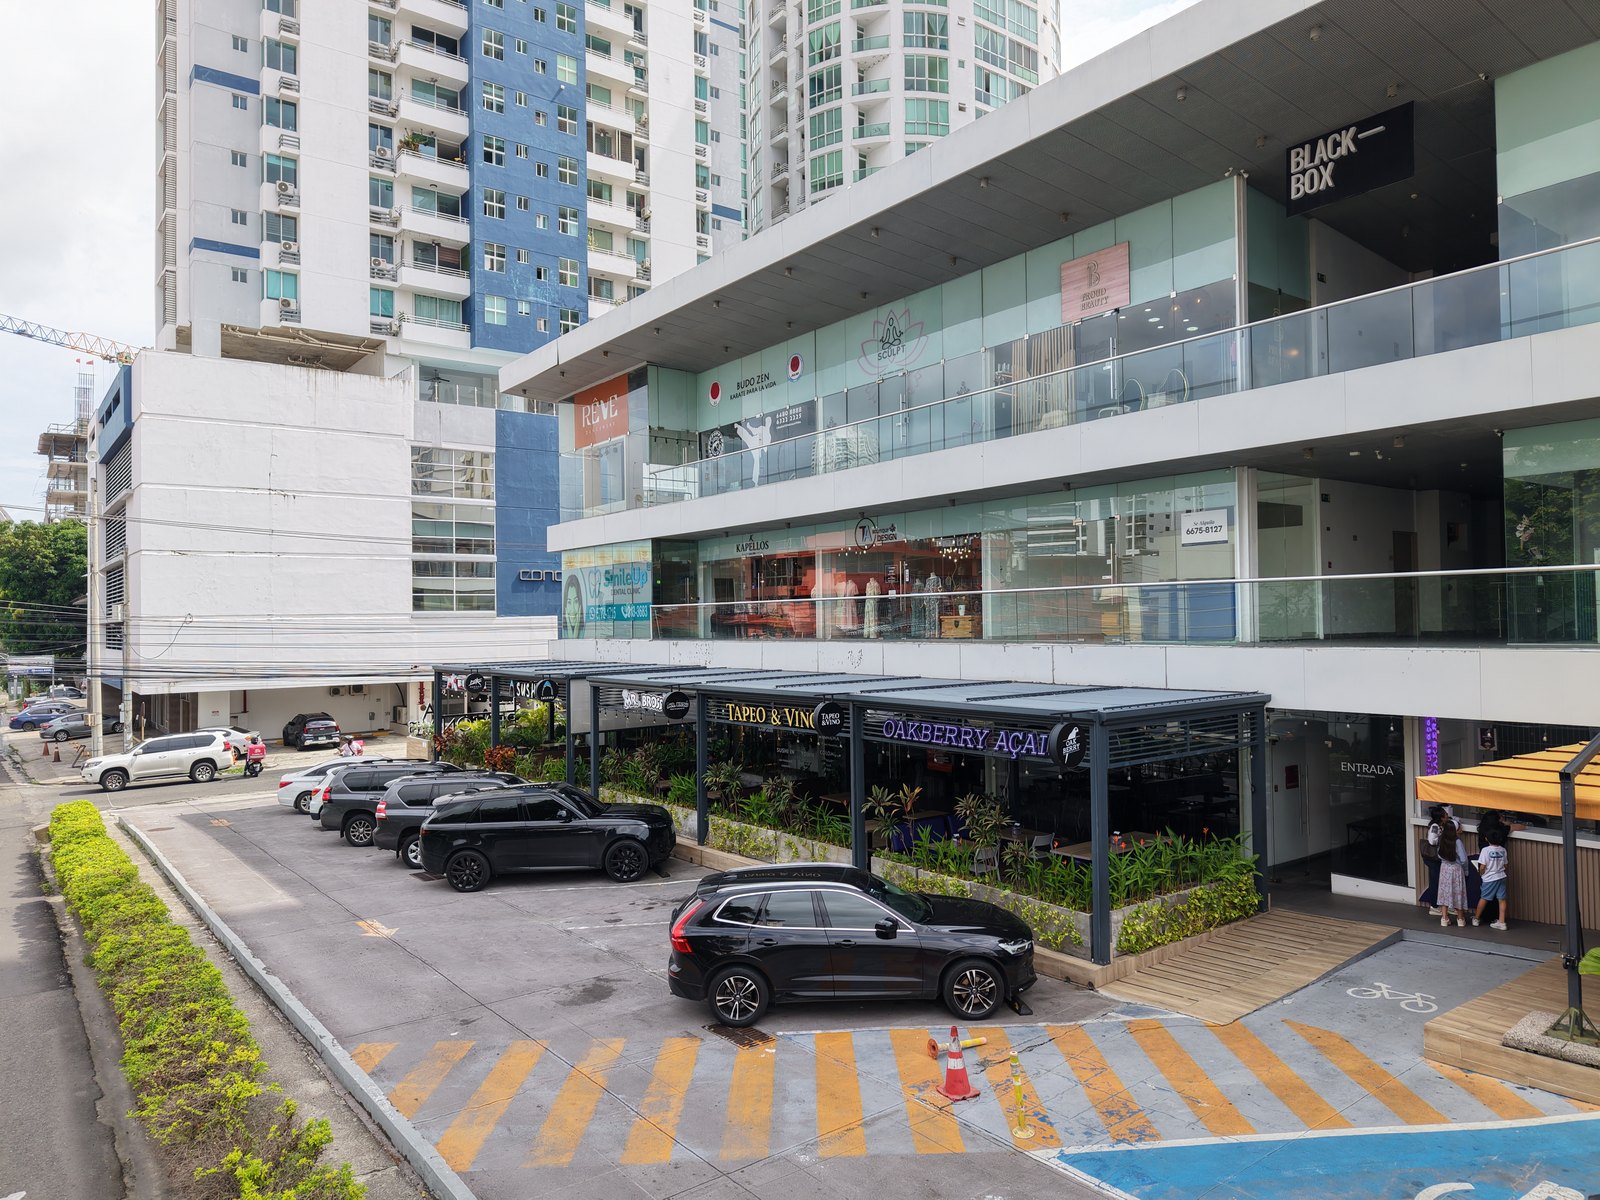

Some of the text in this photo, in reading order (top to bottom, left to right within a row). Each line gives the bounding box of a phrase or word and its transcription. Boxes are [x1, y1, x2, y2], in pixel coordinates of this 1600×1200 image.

[1290, 126, 1357, 174] BLACK
[1290, 161, 1335, 200] BOX
[1082, 287, 1107, 301] PROUD
[1081, 296, 1109, 311] BEAUTY
[877, 345, 906, 361] SCULPT
[736, 372, 770, 391] BUDO ZEN
[730, 390, 746, 400] KARATE
[746, 386, 758, 395] PARA
[765, 380, 776, 389] VIDA
[582, 394, 618, 428] RÊVE
[877, 533, 897, 542] DESIGN
[1185, 525, 1223, 536] 6675-8127
[736, 540, 769, 553] KAPELLOS
[726, 703, 767, 723] TAPEO
[771, 707, 782, 726] &
[821, 712, 840, 720] TAPEO
[883, 719, 990, 751] OAKBERRY
[1065, 737, 1077, 747] OAK
[1062, 743, 1081, 755] BERRY
[1341, 761, 1394, 776] ENTRADA
